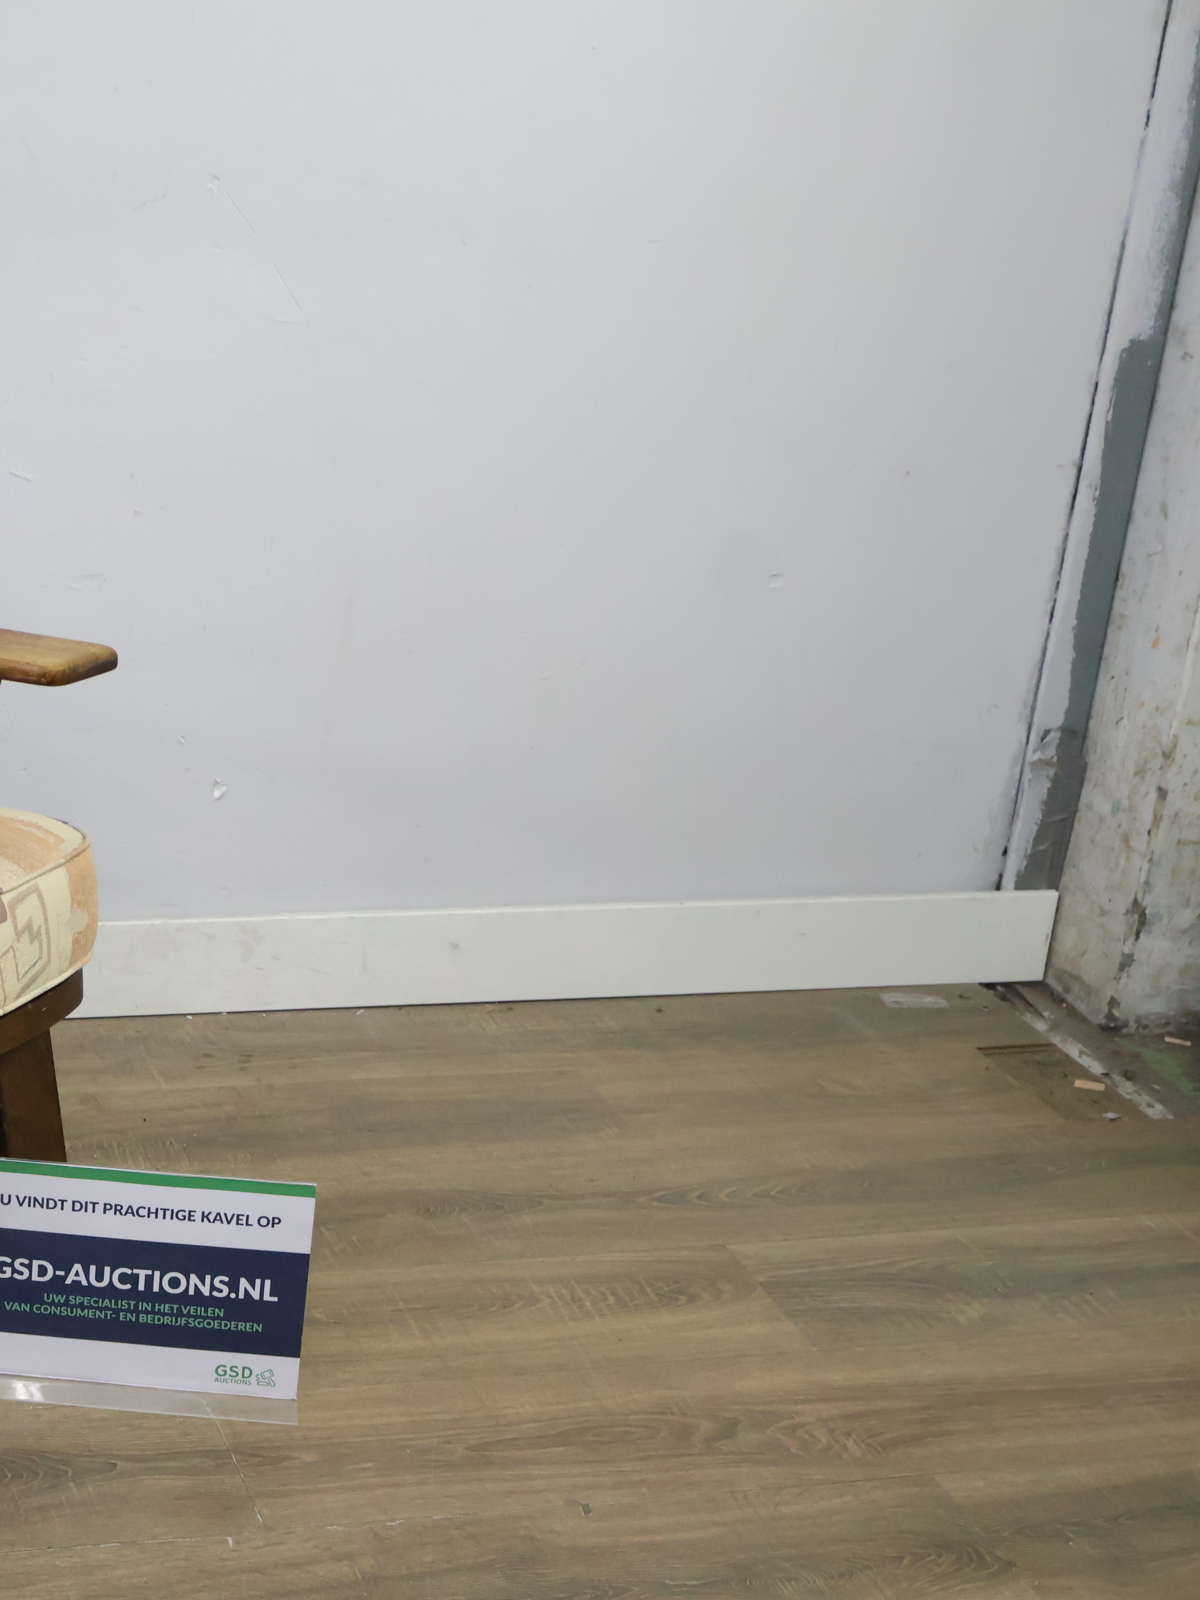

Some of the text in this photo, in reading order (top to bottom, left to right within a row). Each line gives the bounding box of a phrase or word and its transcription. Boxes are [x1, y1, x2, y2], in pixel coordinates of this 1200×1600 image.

[0, 1194, 281, 1228] U VINDT DIT PRACHTIGE KAVEL OP
[4, 1302, 262, 1332] VAN CONSUMENT- EN BEDRIJFSGOEDEREN
[44, 1293, 224, 1317] UW SPECIALIST IN HET VEILEN
[214, 1377, 251, 1386] AUCTIONS
[215, 1365, 253, 1379] GSD
